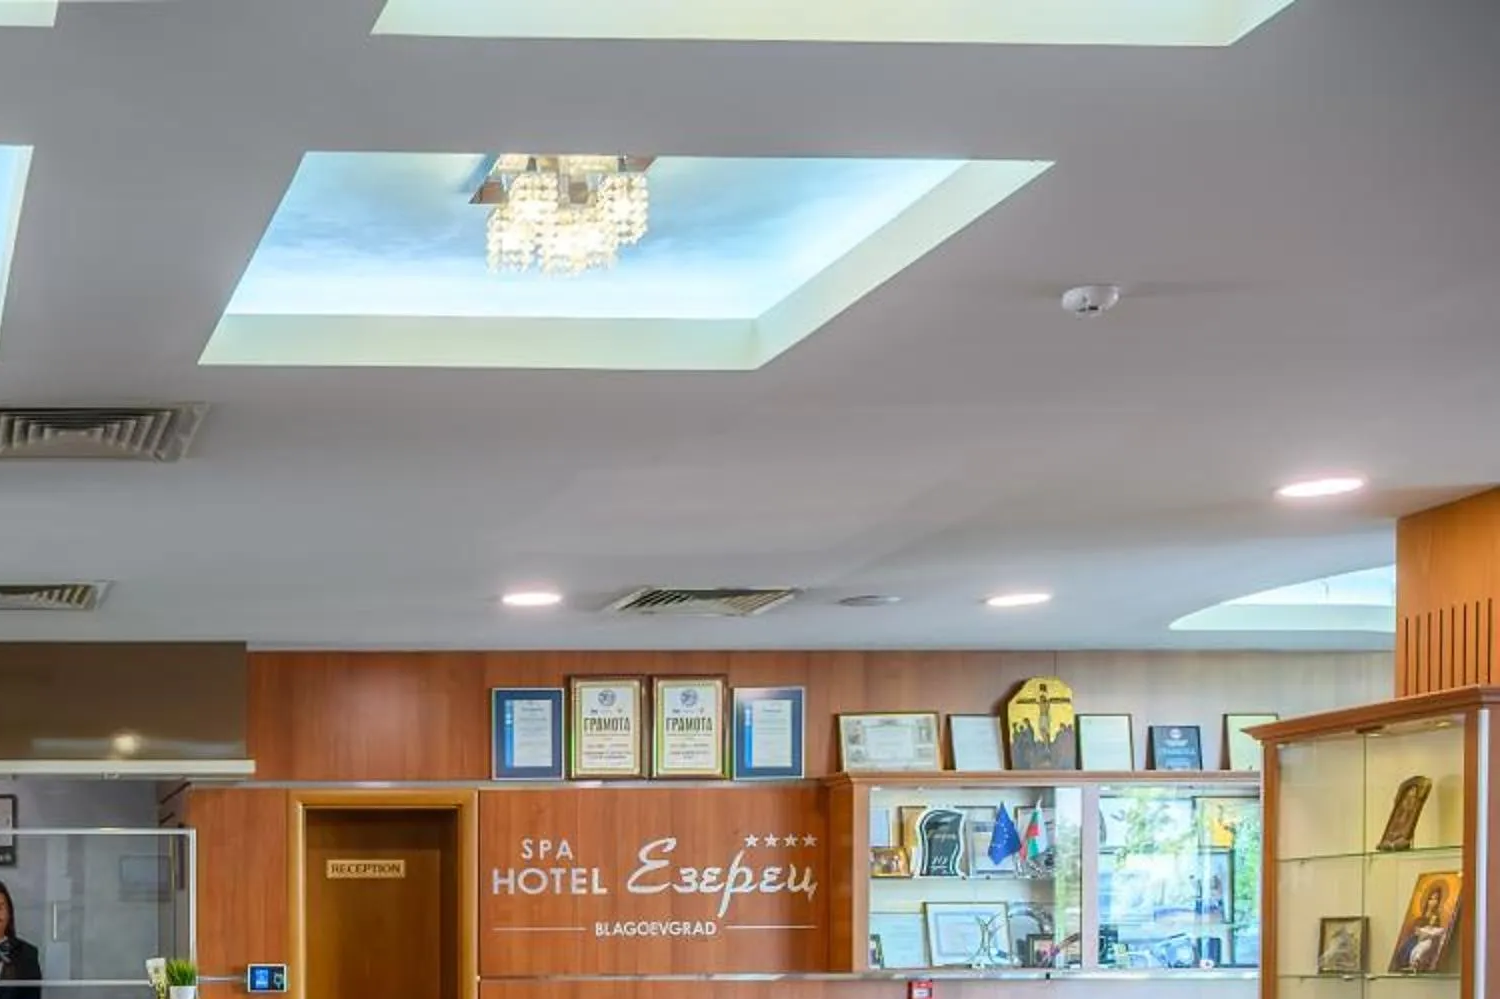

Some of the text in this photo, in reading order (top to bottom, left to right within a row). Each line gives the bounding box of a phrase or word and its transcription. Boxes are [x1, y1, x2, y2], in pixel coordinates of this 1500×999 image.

[583, 717, 631, 732] ГРАМОТА
[665, 717, 713, 732] ГРАМОТА
[520, 839, 574, 860] SPA
[330, 863, 401, 873] RECEPTION
[491, 837, 818, 918] HOTEL Езерец
[594, 921, 717, 937] BLAGOEVGRAD
